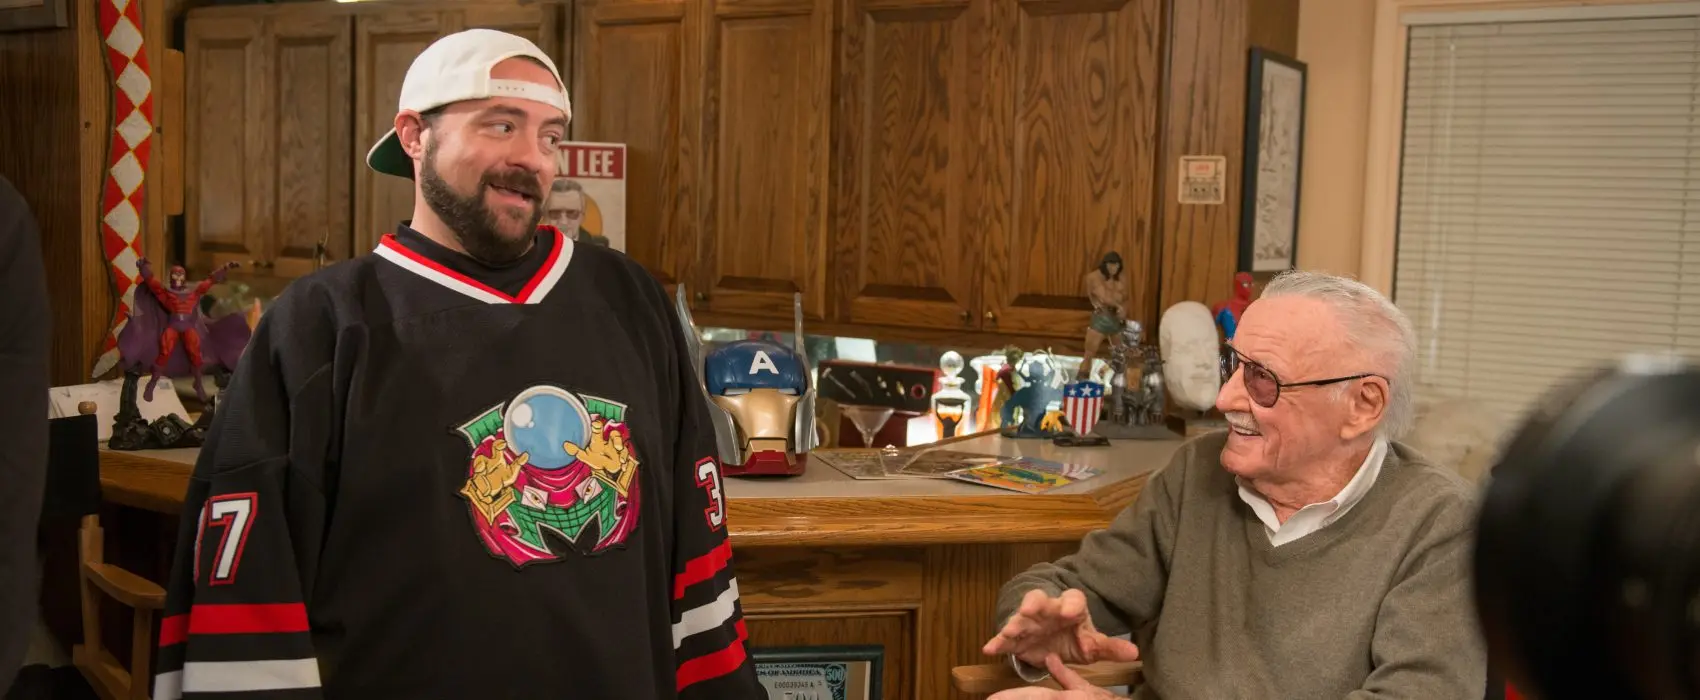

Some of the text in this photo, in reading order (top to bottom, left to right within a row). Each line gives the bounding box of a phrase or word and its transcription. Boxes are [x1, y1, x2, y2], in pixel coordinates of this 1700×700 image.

[576, 149, 614, 177] LEE
[749, 351, 779, 374] A
[694, 456, 727, 532] 3
[194, 492, 258, 586] 7
